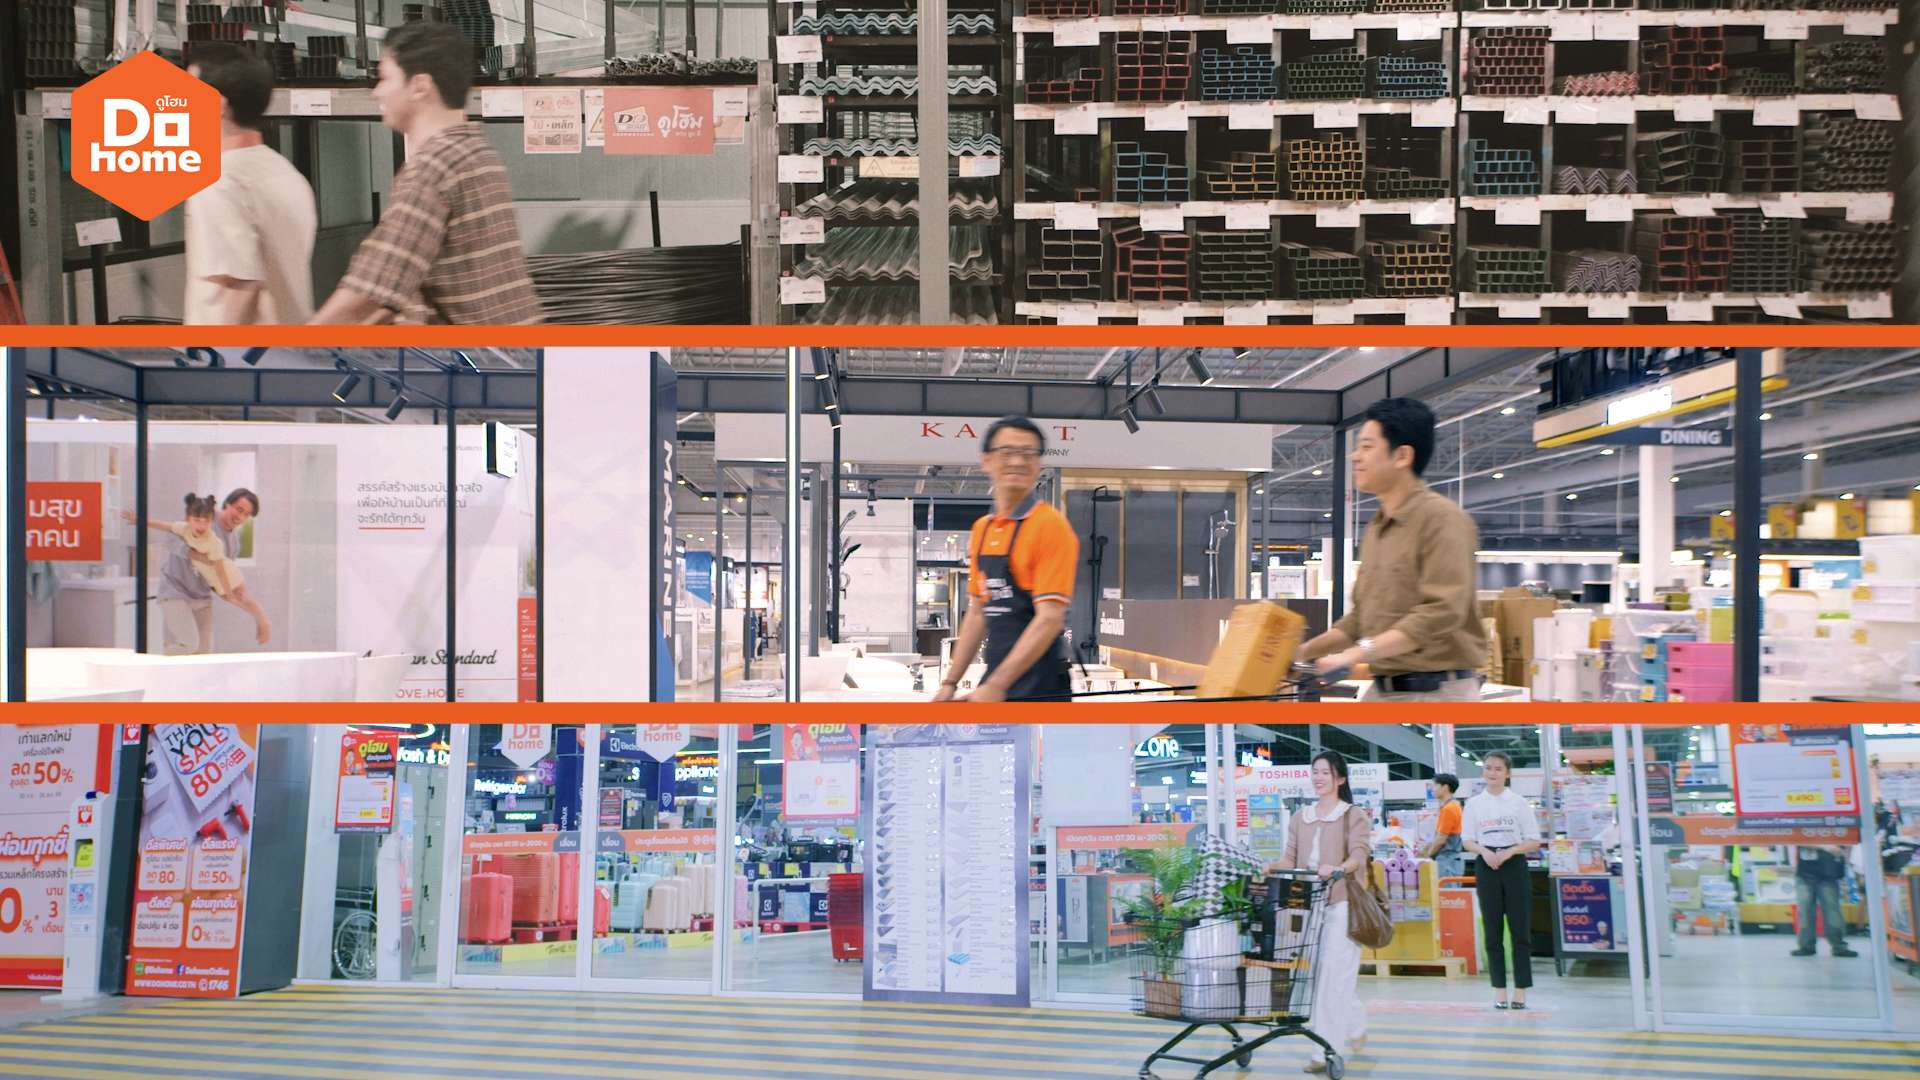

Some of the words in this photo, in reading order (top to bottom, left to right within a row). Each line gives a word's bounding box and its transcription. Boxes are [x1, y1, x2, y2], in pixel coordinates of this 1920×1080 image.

[1660, 429, 1721, 445] DINING
[663, 440, 673, 639] MARINE
[18, 728, 72, 744] เก่าแลกใหม่
[508, 739, 544, 749] home
[644, 732, 682, 742] home
[179, 729, 229, 773] SALE
[11, 762, 31, 776] ลด
[1258, 770, 1310, 779] TOSHIBA
[474, 779, 527, 795] Refrigerator
[49, 901, 58, 918] 3
